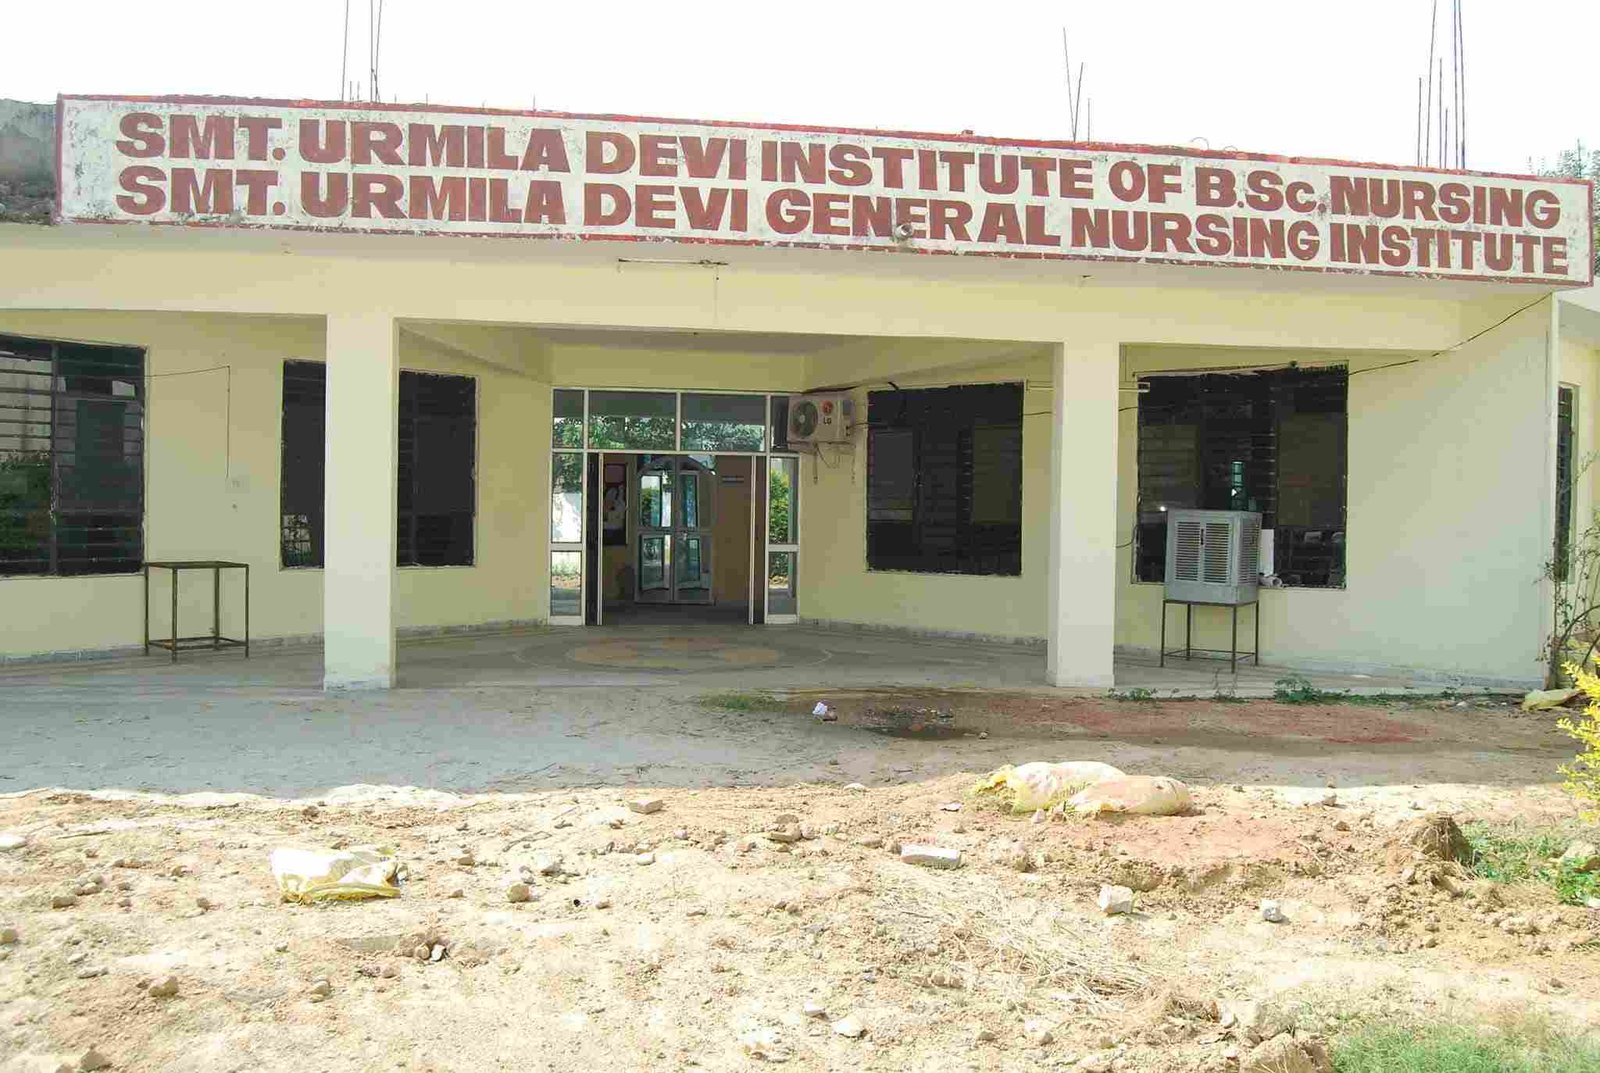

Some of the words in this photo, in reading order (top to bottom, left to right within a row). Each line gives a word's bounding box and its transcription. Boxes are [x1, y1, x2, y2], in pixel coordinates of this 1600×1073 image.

[116, 112, 286, 162] SMT.
[299, 120, 569, 174] URMILA
[585, 131, 747, 181] DEVI
[761, 141, 1094, 200] INSTITUTE
[1108, 160, 1182, 204] OF
[1195, 166, 1327, 214] B.Sc.
[1330, 176, 1559, 230] NURSING
[116, 165, 286, 216] SMT.
[300, 173, 566, 225] URMILA
[584, 184, 748, 233] DEVI
[766, 189, 1061, 247] GENERAL
[1070, 208, 1320, 261] NURSING
[1330, 222, 1568, 282] INSTITUTE
[822, 417, 832, 425] LG
